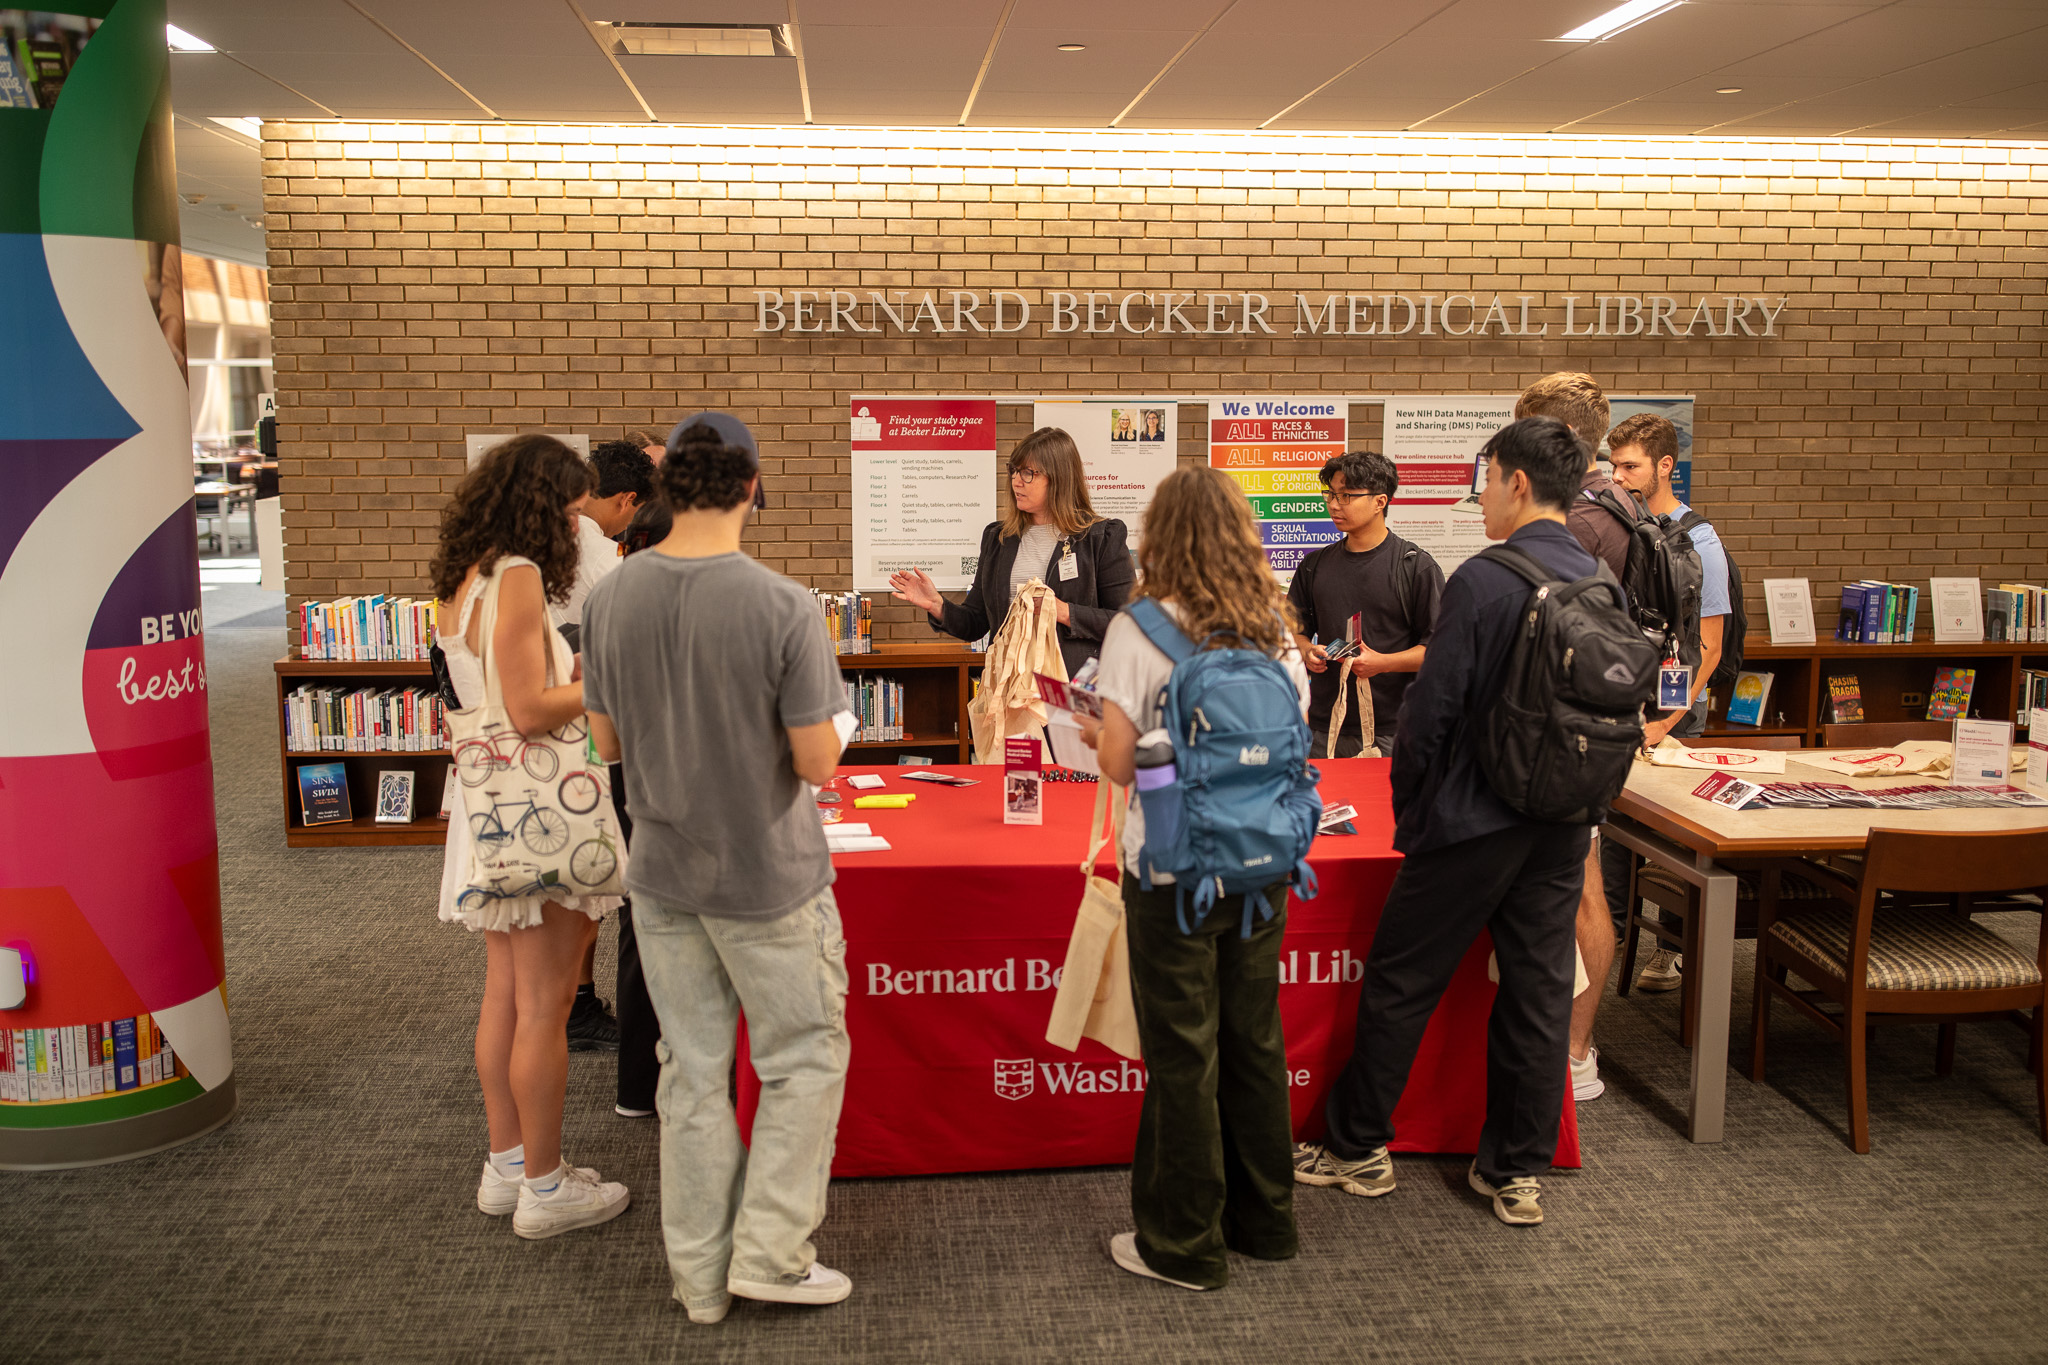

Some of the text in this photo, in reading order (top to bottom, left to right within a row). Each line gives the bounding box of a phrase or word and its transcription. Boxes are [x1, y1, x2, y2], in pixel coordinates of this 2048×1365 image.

[752, 290, 1790, 338] BERNARD BECKER MEDICAL LIBRARY
[1222, 401, 1335, 416] We Welcome
[1396, 410, 1511, 420] New NIH Data Management
[889, 415, 983, 427] Find your study space
[1272, 422, 1312, 431] RACES &
[1396, 421, 1502, 431] and Sharing (DMS) Policy
[889, 427, 966, 438] at Becker Library
[1226, 422, 1265, 440] ALL
[1272, 430, 1330, 440] ETHNICITIES
[1226, 448, 1265, 466] ALL
[1272, 450, 1333, 462] RELIGIONS
[1272, 473, 1320, 482] COUNTRIE
[1272, 482, 1321, 491] OF ORIGIN
[1272, 502, 1325, 513] GENDERS
[1272, 524, 1307, 533] SEXUAL
[1271, 532, 1340, 542] ORIENTATIONS
[1270, 550, 1305, 560] AGES &
[141, 614, 176, 645] BE
[116, 657, 195, 705] best
[1668, 672, 1682, 684] Y
[1828, 676, 1858, 687] CHASING
[1671, 689, 1676, 697] 7
[1830, 685, 1860, 697] DRAGON
[312, 776, 336, 786] SINK
[312, 788, 339, 798] SWIM
[866, 958, 1016, 996] Bernard
[1038, 1060, 1149, 1095] Wash
